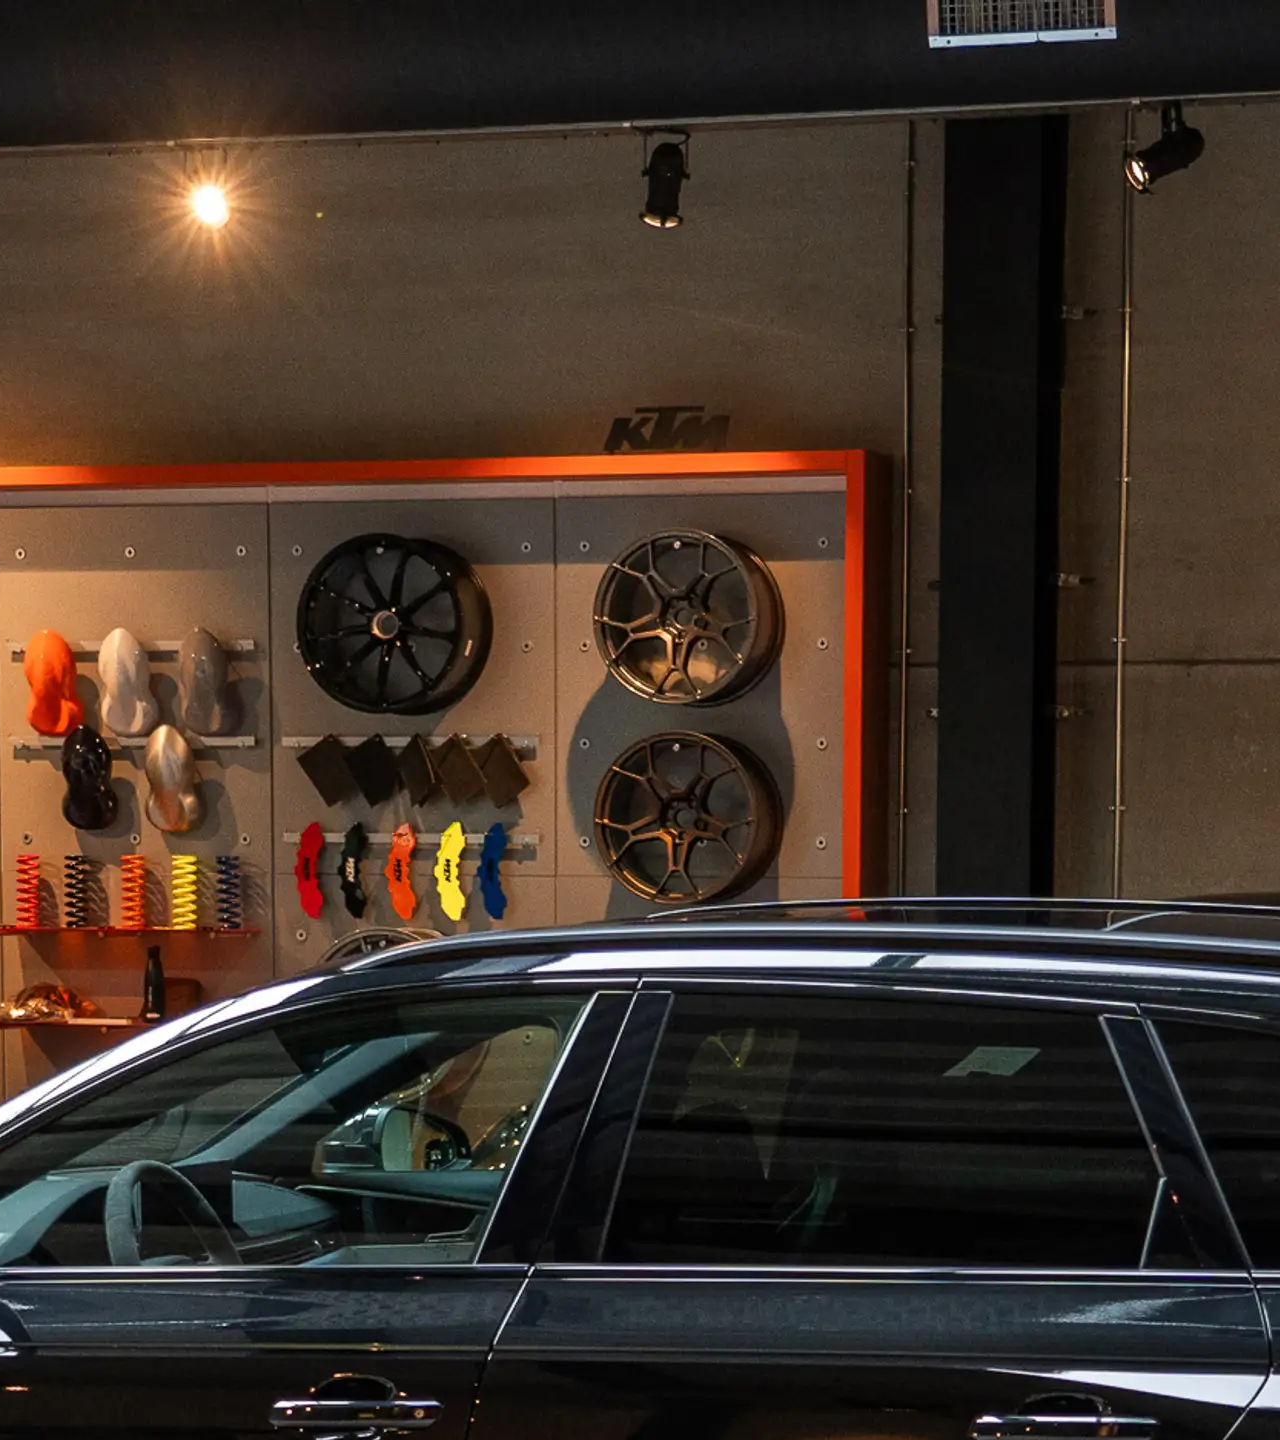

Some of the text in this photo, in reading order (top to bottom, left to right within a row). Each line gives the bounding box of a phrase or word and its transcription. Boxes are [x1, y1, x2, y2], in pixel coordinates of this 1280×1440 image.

[604, 406, 730, 451] KTM
[345, 856, 356, 883] KTM
[393, 858, 403, 883] KTM
[443, 858, 452, 883] KTM
